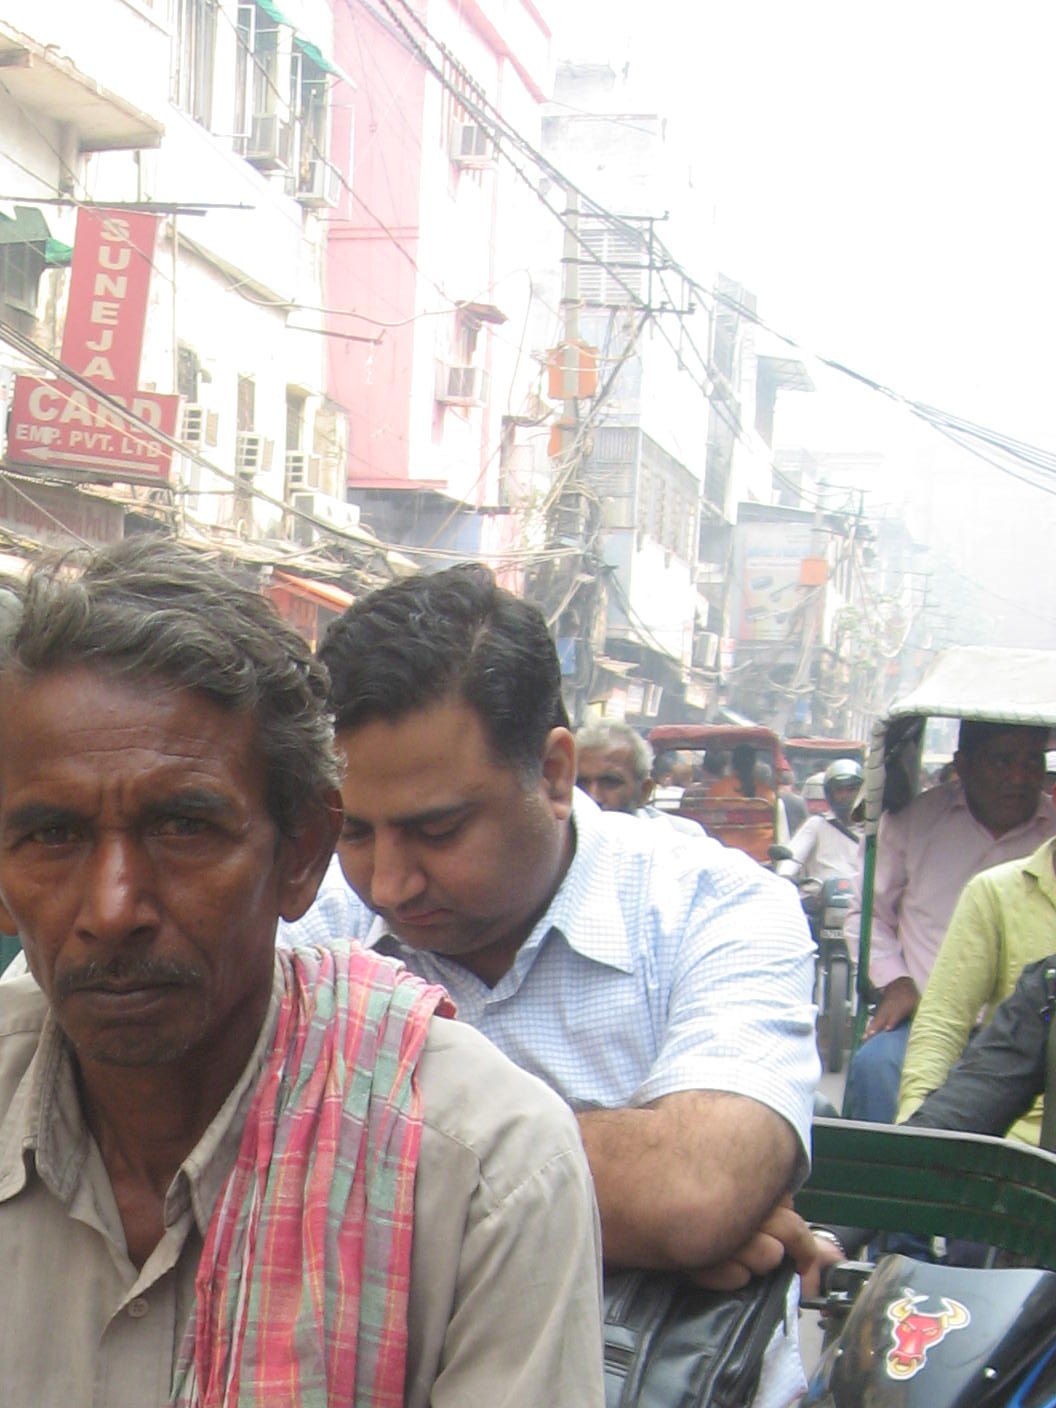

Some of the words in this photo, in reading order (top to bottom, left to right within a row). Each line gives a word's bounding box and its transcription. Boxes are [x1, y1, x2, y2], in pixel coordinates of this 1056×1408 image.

[80, 218, 131, 381] SUNEJA
[28, 386, 163, 434] CARD
[15, 424, 62, 445] EMP.
[69, 430, 115, 452] PVT.
